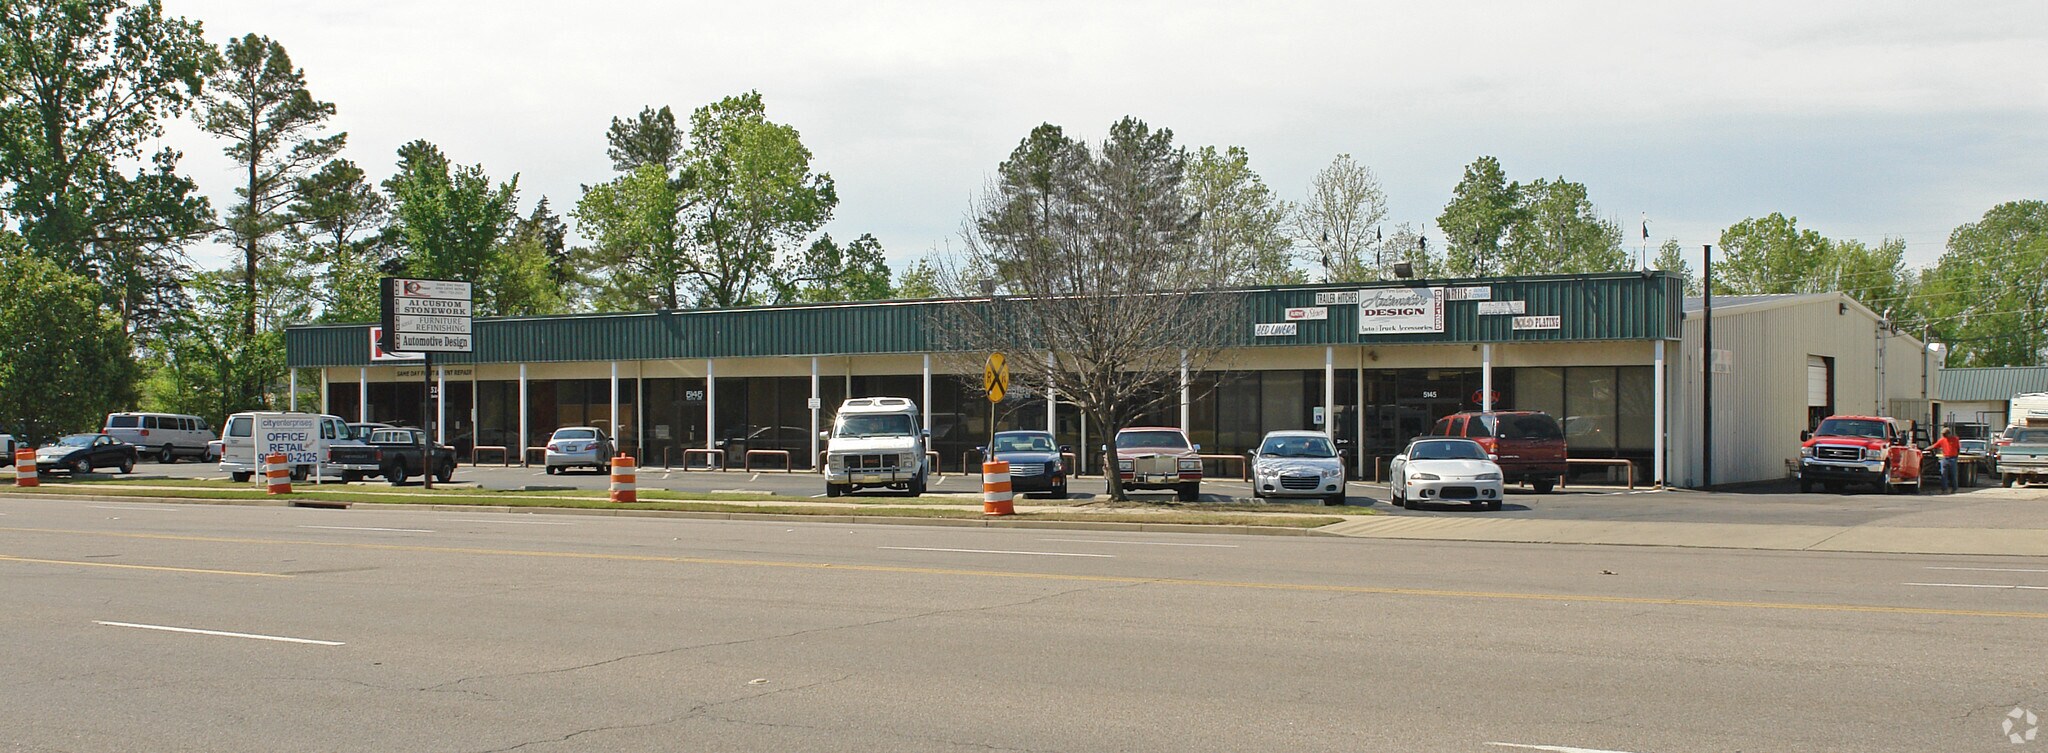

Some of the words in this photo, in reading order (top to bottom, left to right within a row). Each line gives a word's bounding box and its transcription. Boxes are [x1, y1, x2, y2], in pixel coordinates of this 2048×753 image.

[1317, 293, 1336, 303] TRAILER
[1337, 292, 1358, 303] HITCHES
[404, 306, 466, 315] STONEWORK
[1364, 308, 1426, 316] DESIGN
[419, 317, 463, 325] FURNITURE
[1535, 317, 1559, 327] PLATING
[416, 324, 466, 332] REFINISHING
[403, 336, 443, 347] Automotive
[444, 337, 468, 349] Design
[267, 432, 309, 441] OFFICE/
[269, 443, 307, 452] RETAIL
